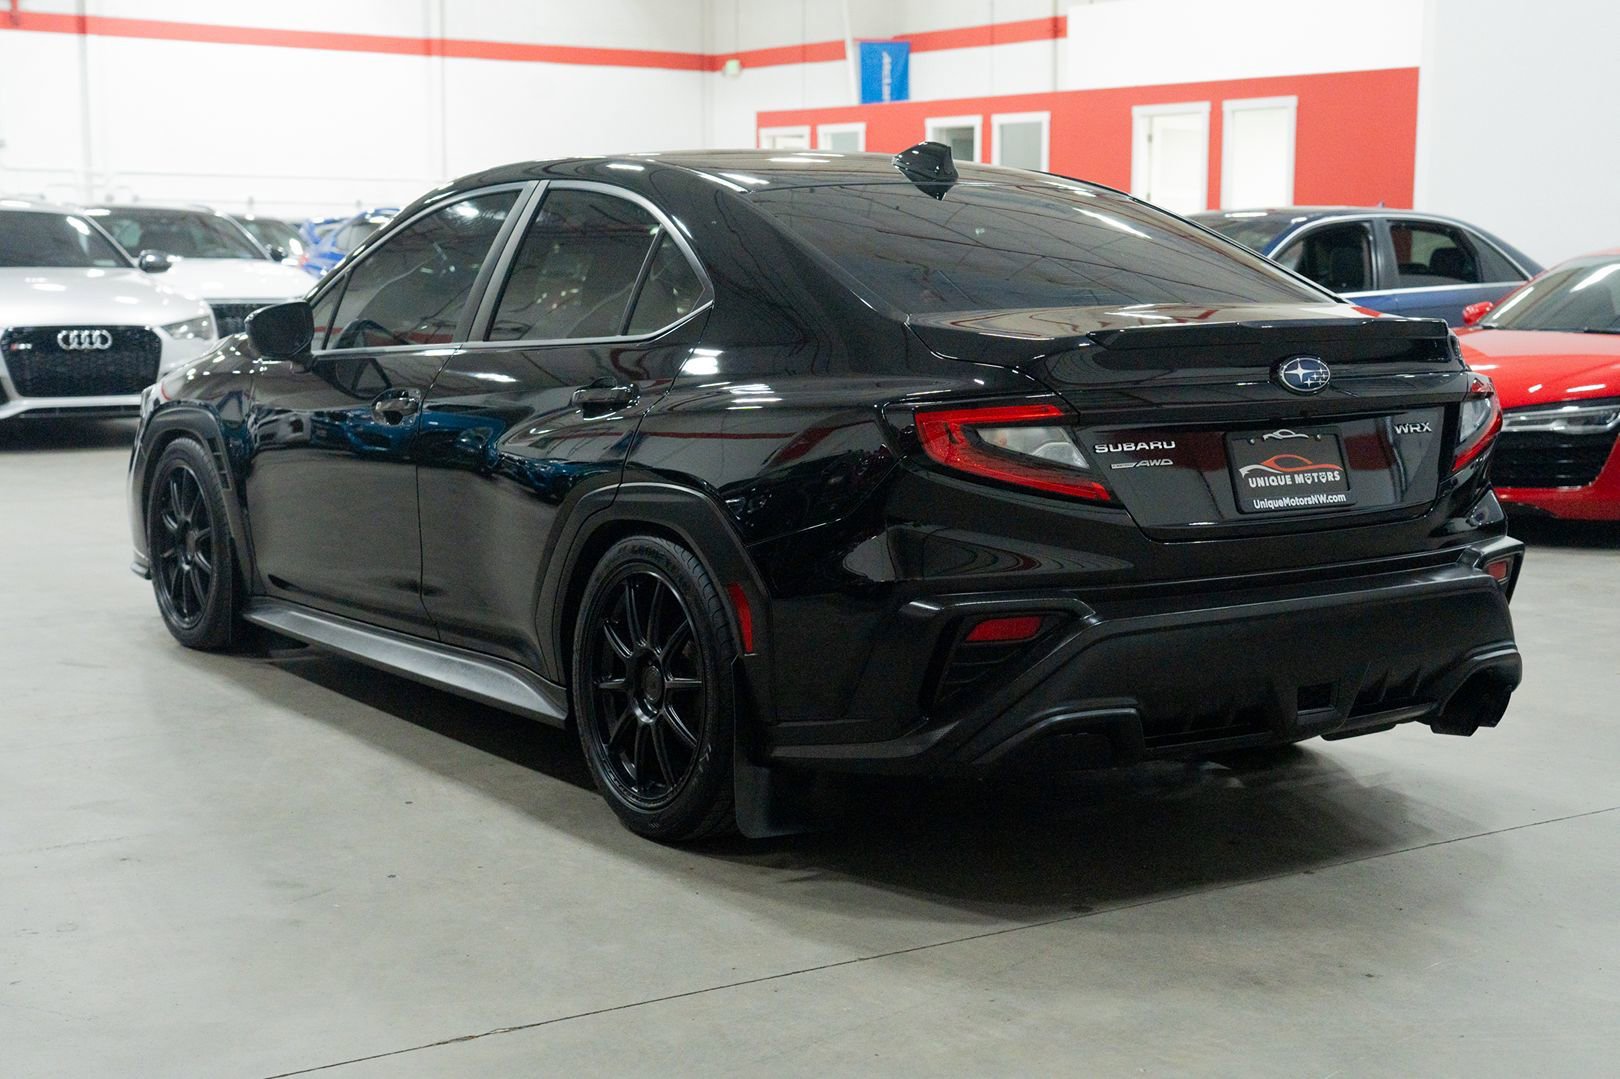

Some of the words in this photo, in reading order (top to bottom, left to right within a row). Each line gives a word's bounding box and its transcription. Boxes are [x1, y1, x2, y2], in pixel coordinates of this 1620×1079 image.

[1393, 422, 1432, 434] WRX
[1094, 440, 1176, 453] SUBARU
[1136, 458, 1174, 468] AWD
[1248, 474, 1293, 488] UNIQUE
[1294, 471, 1341, 485] MOTORS
[1253, 494, 1347, 510] UniqueMotorsNW.com
